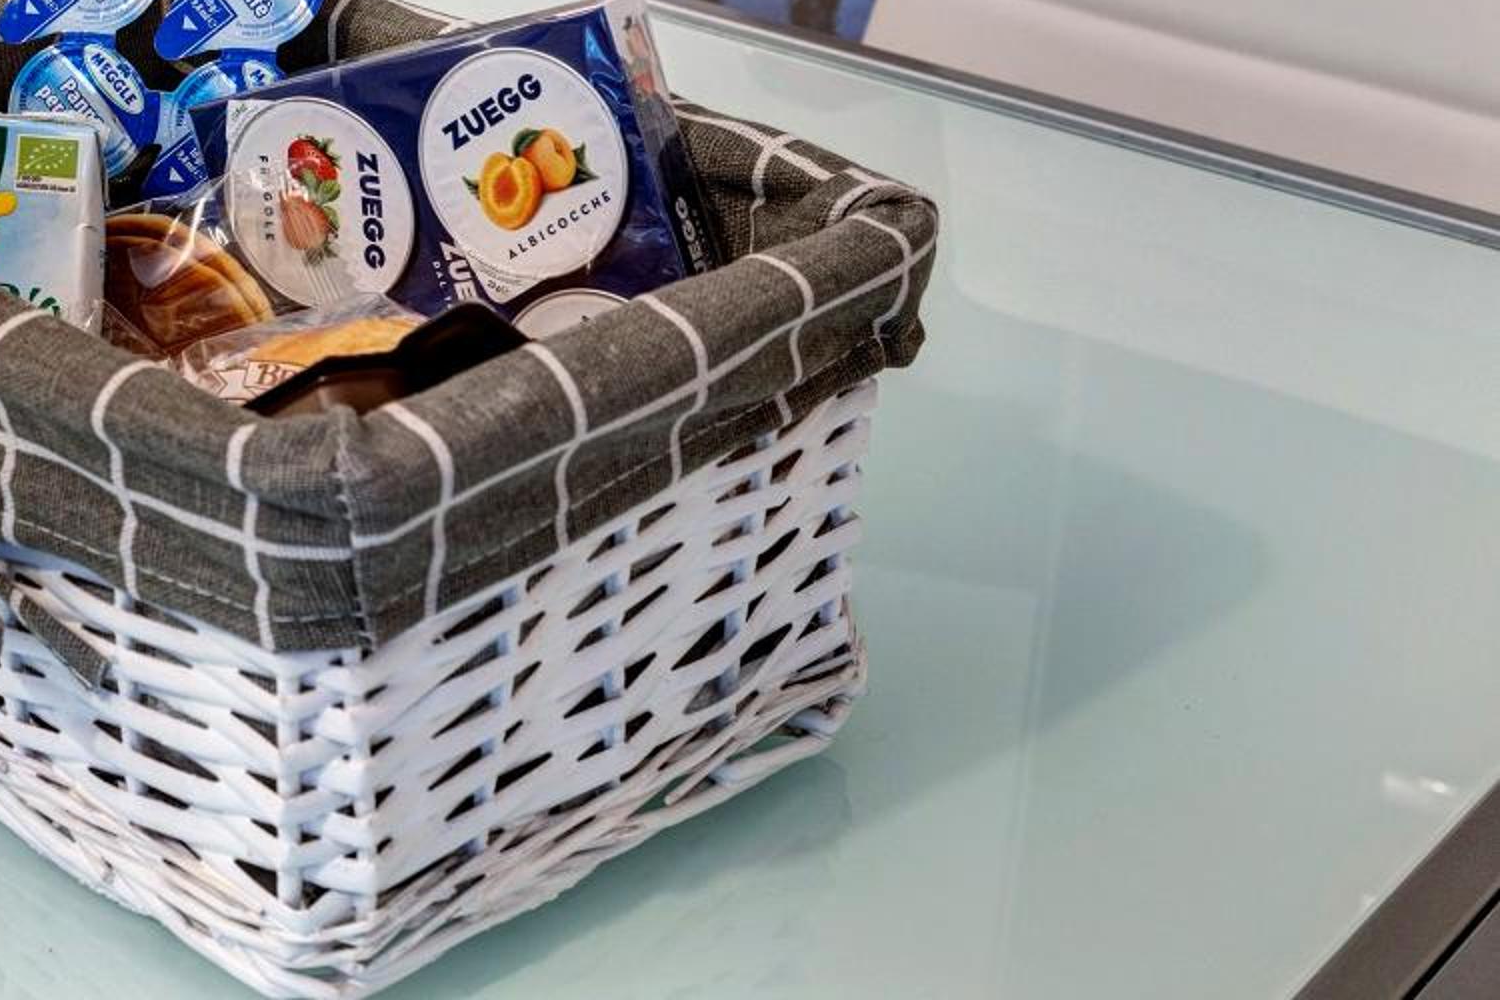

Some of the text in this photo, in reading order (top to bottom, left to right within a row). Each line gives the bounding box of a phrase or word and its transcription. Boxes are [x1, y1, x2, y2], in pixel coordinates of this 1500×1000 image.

[90, 53, 137, 106] MEGGLE
[442, 73, 544, 152] ZUEGG
[257, 154, 276, 242] FGOLE
[355, 151, 386, 271] ZUEGG
[507, 189, 614, 261] ALBICOCCHE
[674, 195, 708, 273] UEGG
